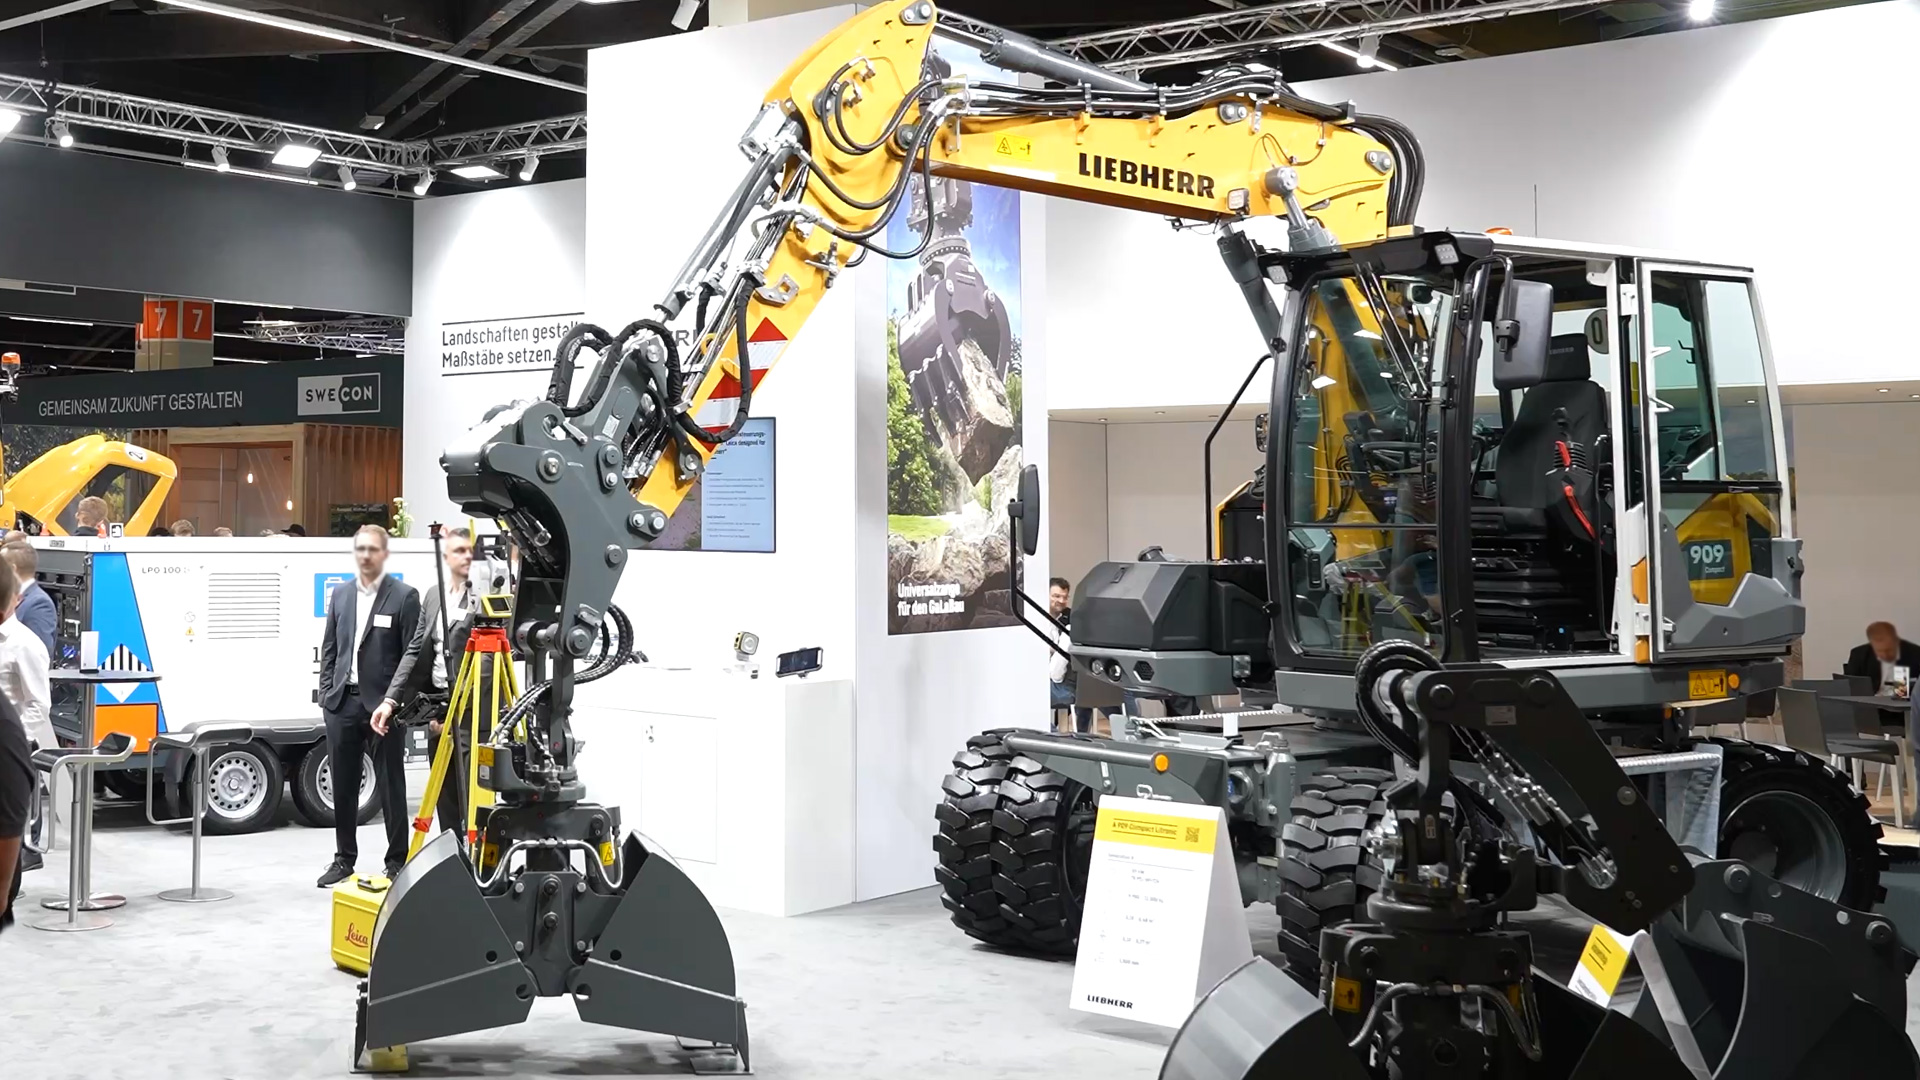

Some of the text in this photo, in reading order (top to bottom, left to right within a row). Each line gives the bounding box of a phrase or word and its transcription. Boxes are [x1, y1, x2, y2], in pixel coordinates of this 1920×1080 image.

[1079, 152, 1215, 199] LIEBHERR
[154, 307, 167, 332] 7
[192, 309, 203, 333] 7
[442, 326, 529, 346] Landschaften
[442, 347, 558, 368] Maßstäbe setzen.
[38, 390, 243, 417] GEMEINSAM ZUKUNFT GESTALTEN
[305, 385, 373, 403] SWECON
[1690, 544, 1725, 564] 909
[163, 566, 182, 574] 100
[898, 582, 960, 598] Universalzange
[898, 601, 911, 616] für
[912, 601, 927, 615] den
[345, 922, 369, 948] Leica
[1087, 994, 1134, 1010] LIEBHERR
